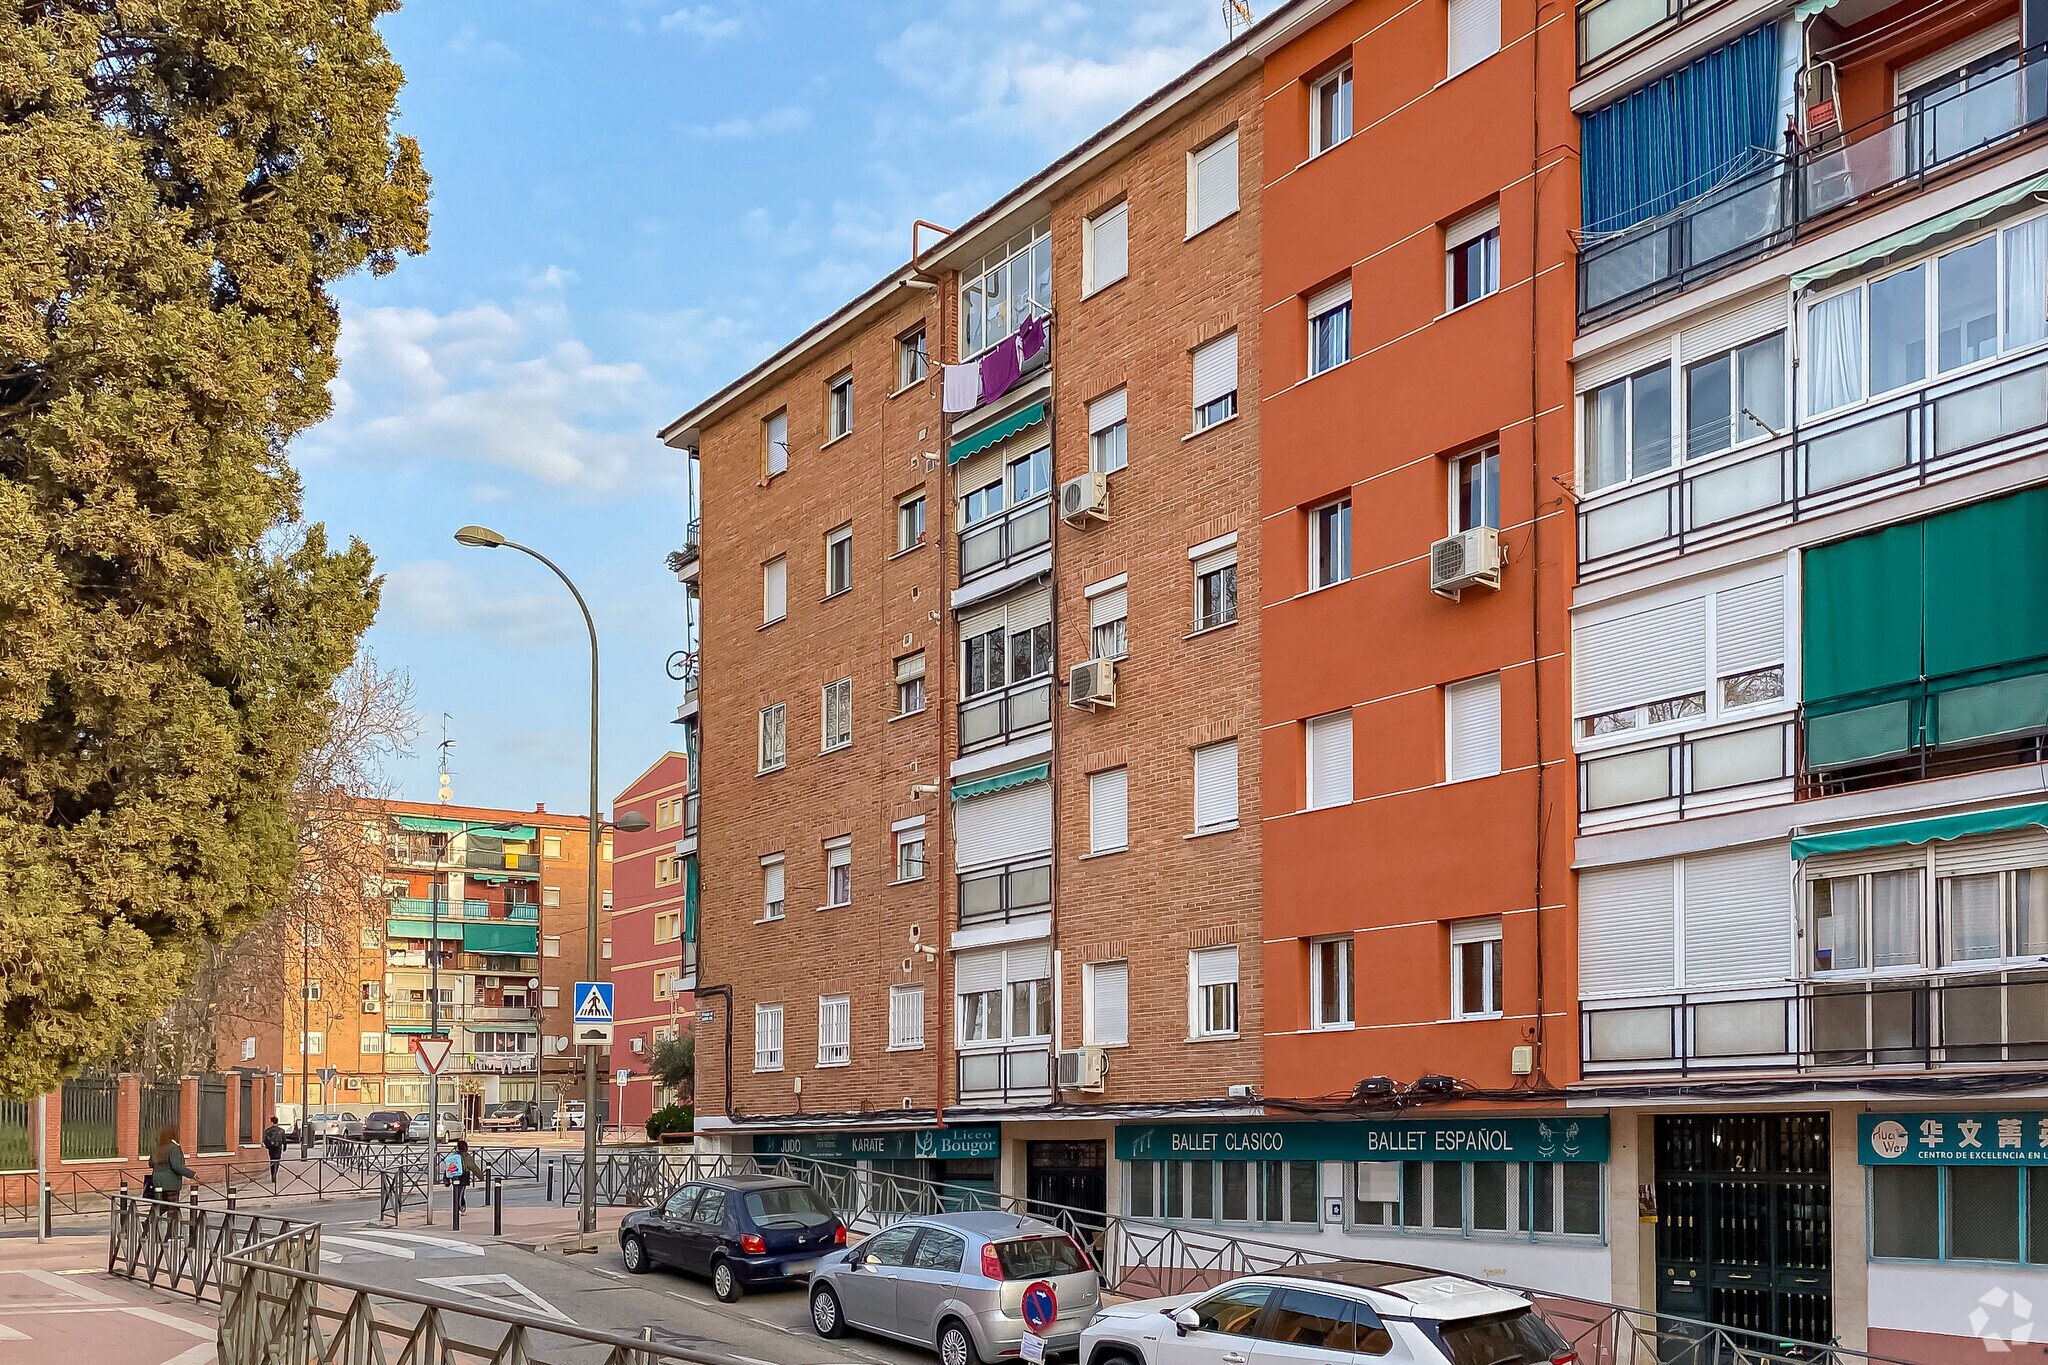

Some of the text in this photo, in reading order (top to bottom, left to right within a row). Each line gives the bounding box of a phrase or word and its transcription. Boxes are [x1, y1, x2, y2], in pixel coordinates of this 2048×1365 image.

[780, 1139, 801, 1153] JUDO
[852, 1138, 885, 1153] KARATE
[941, 1138, 996, 1156] Bougor
[1172, 1132, 1283, 1151] BALLET CLASICO
[1368, 1128, 1513, 1151] BALLET ESPAÑOL
[1735, 1155, 1742, 1168] 2
[1918, 1151, 1954, 1159] CENTRO
[1955, 1151, 1967, 1159] DE
[1969, 1151, 2026, 1160] EXCELENCIA
[2028, 1151, 2041, 1160] EN
